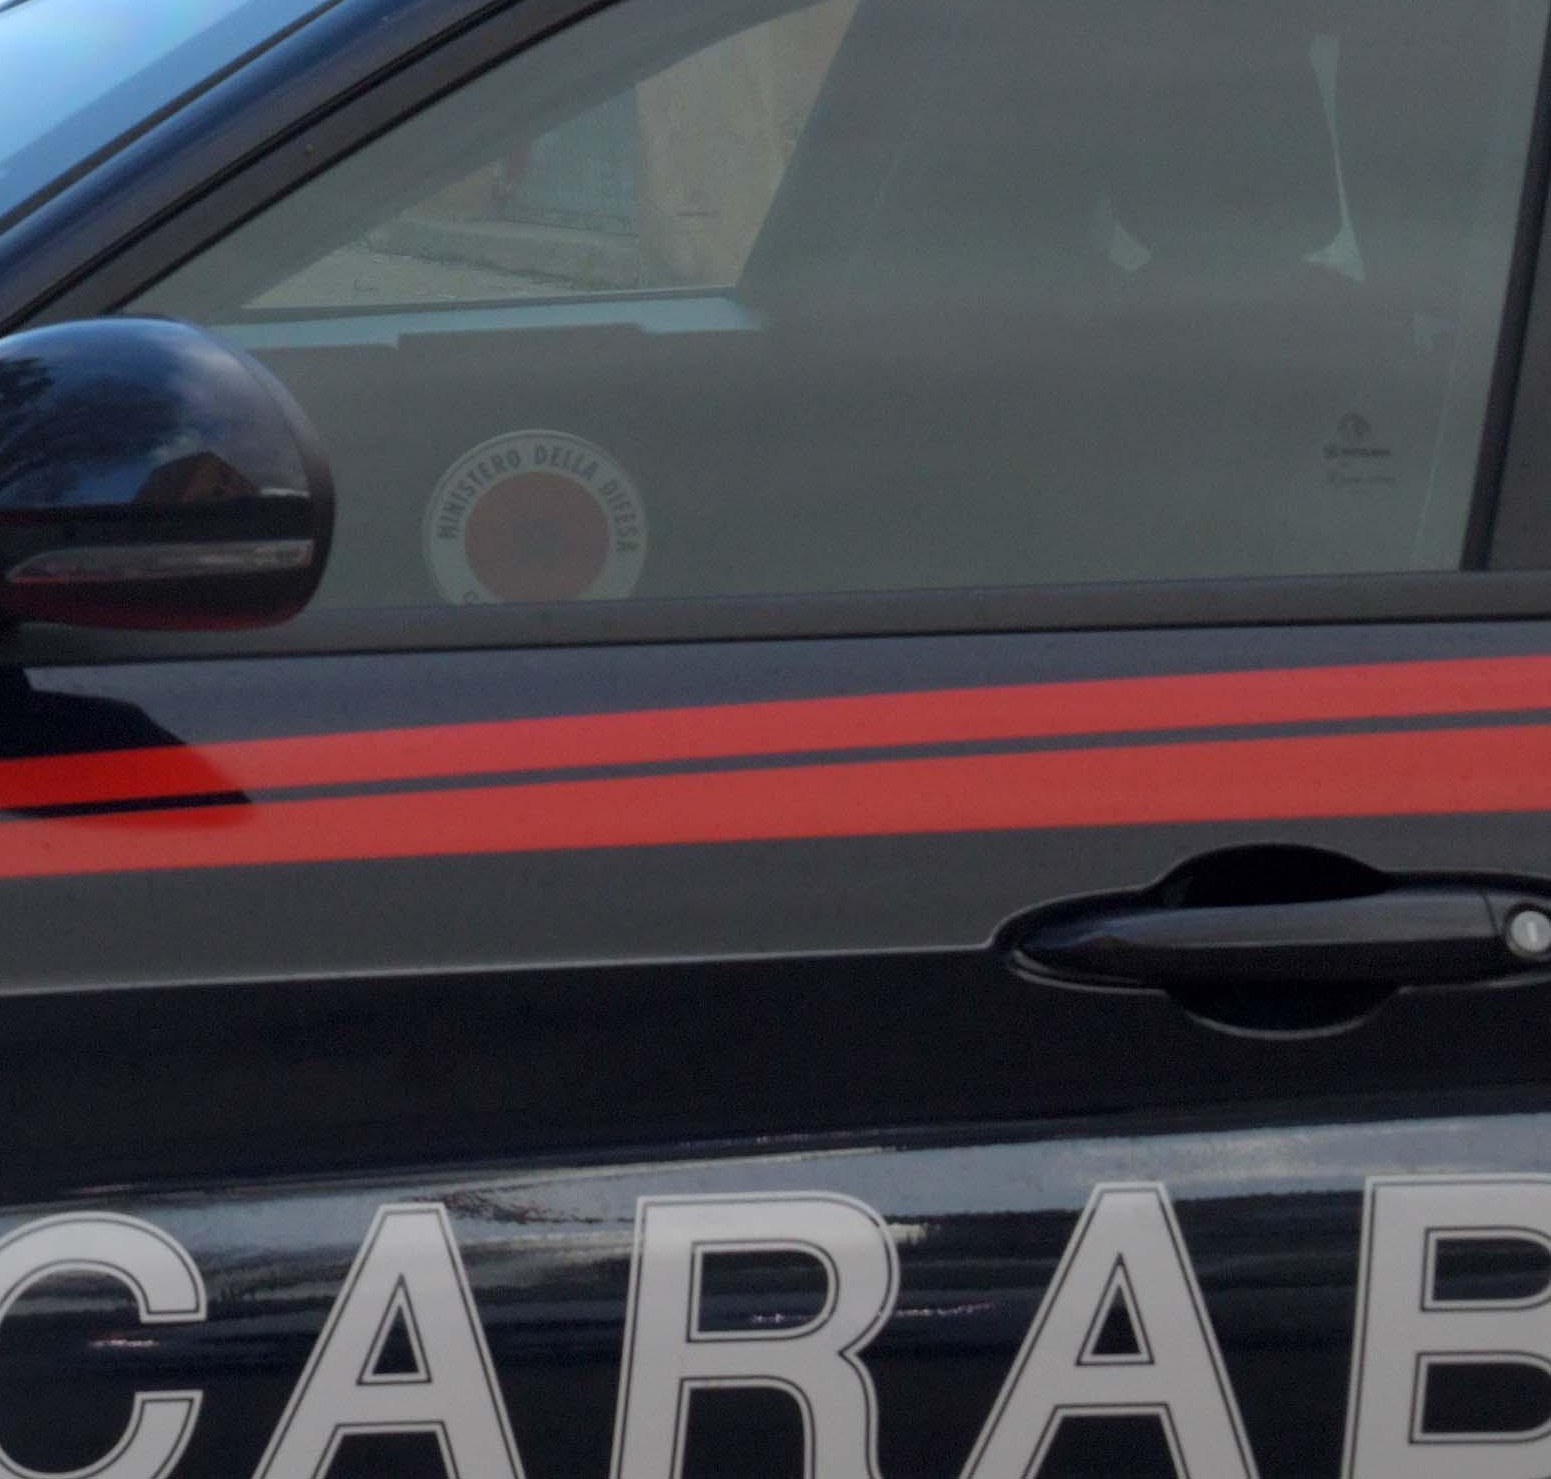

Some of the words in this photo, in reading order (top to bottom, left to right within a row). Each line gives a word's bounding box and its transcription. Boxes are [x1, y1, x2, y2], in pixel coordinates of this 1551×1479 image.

[436, 449, 522, 540] MINISTERO
[534, 444, 600, 481] DELLA
[599, 477, 641, 553] DIFESA
